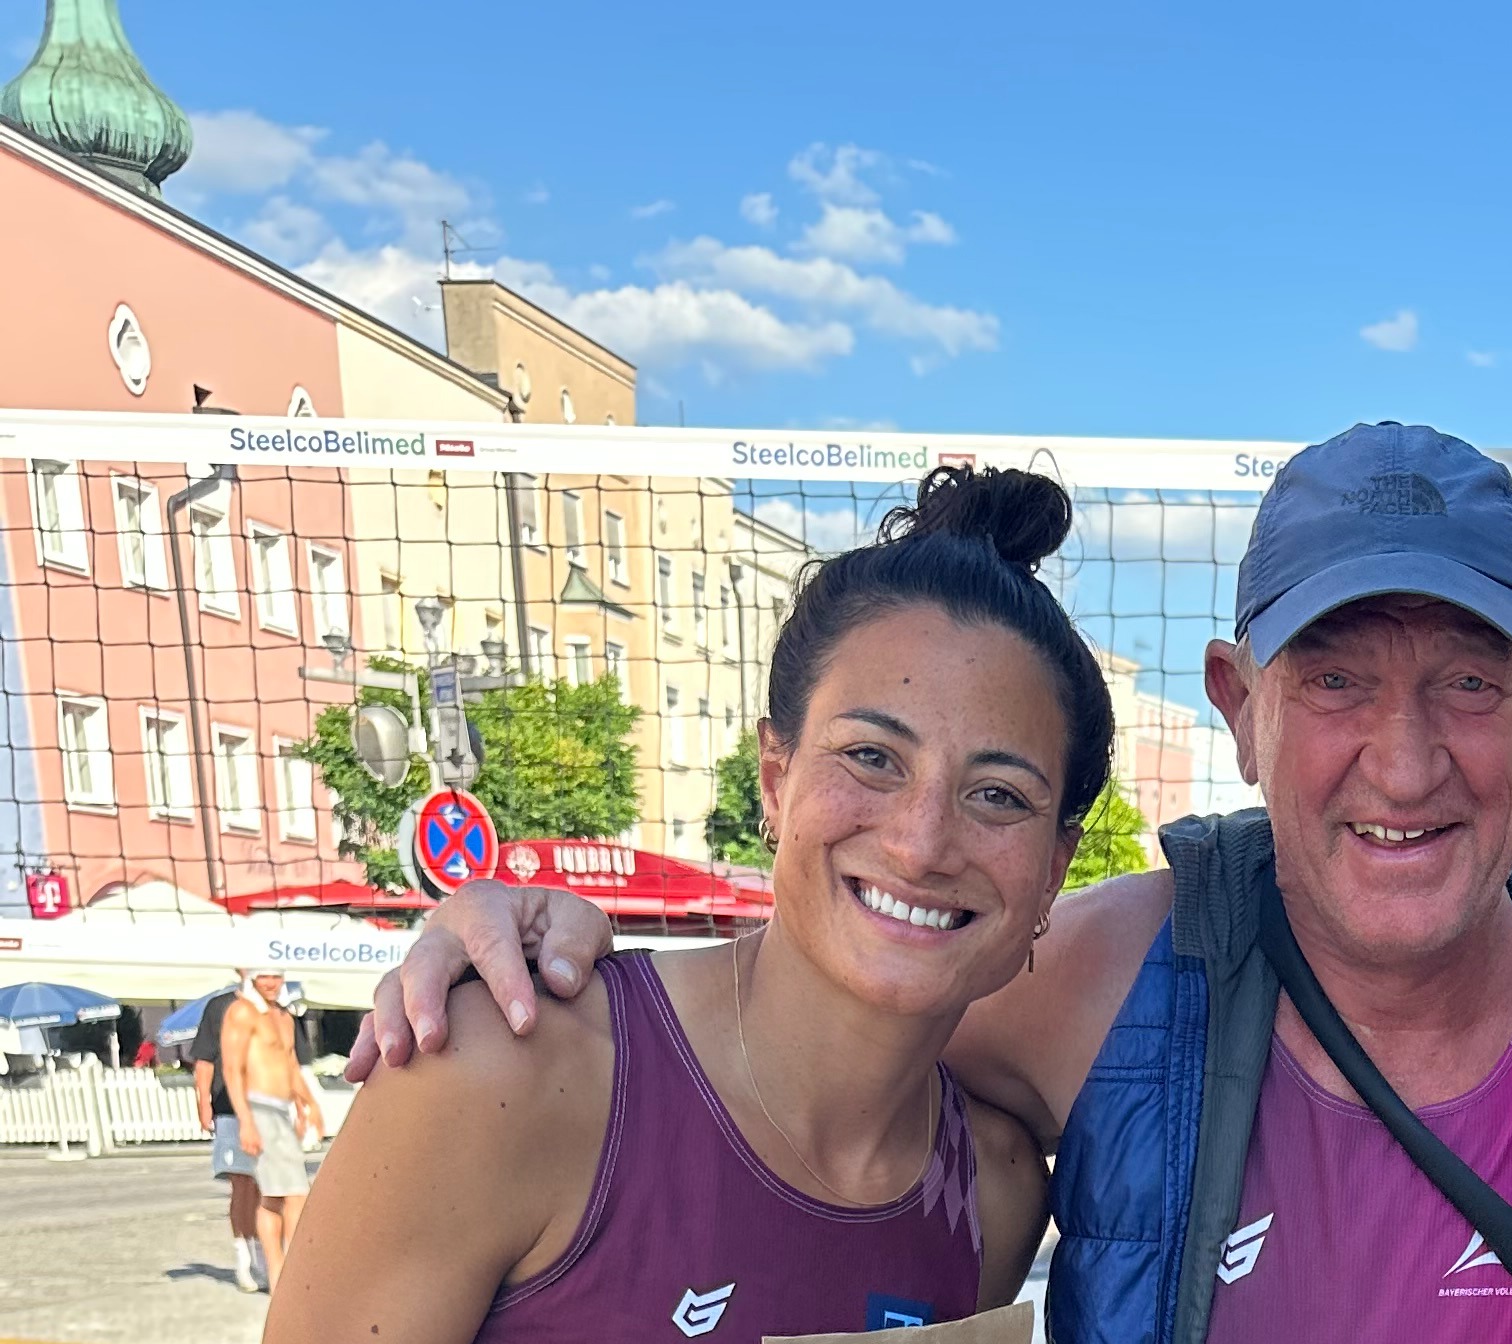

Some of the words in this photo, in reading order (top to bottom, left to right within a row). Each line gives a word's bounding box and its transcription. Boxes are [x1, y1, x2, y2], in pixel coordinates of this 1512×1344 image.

[230, 427, 426, 456] SteelcoBelimed
[733, 441, 928, 469] SteelcoBelimed
[1370, 473, 1411, 490] THE
[268, 940, 404, 964] SteelcoBeli
[1438, 1287, 1494, 1297] BAYERISCHER
